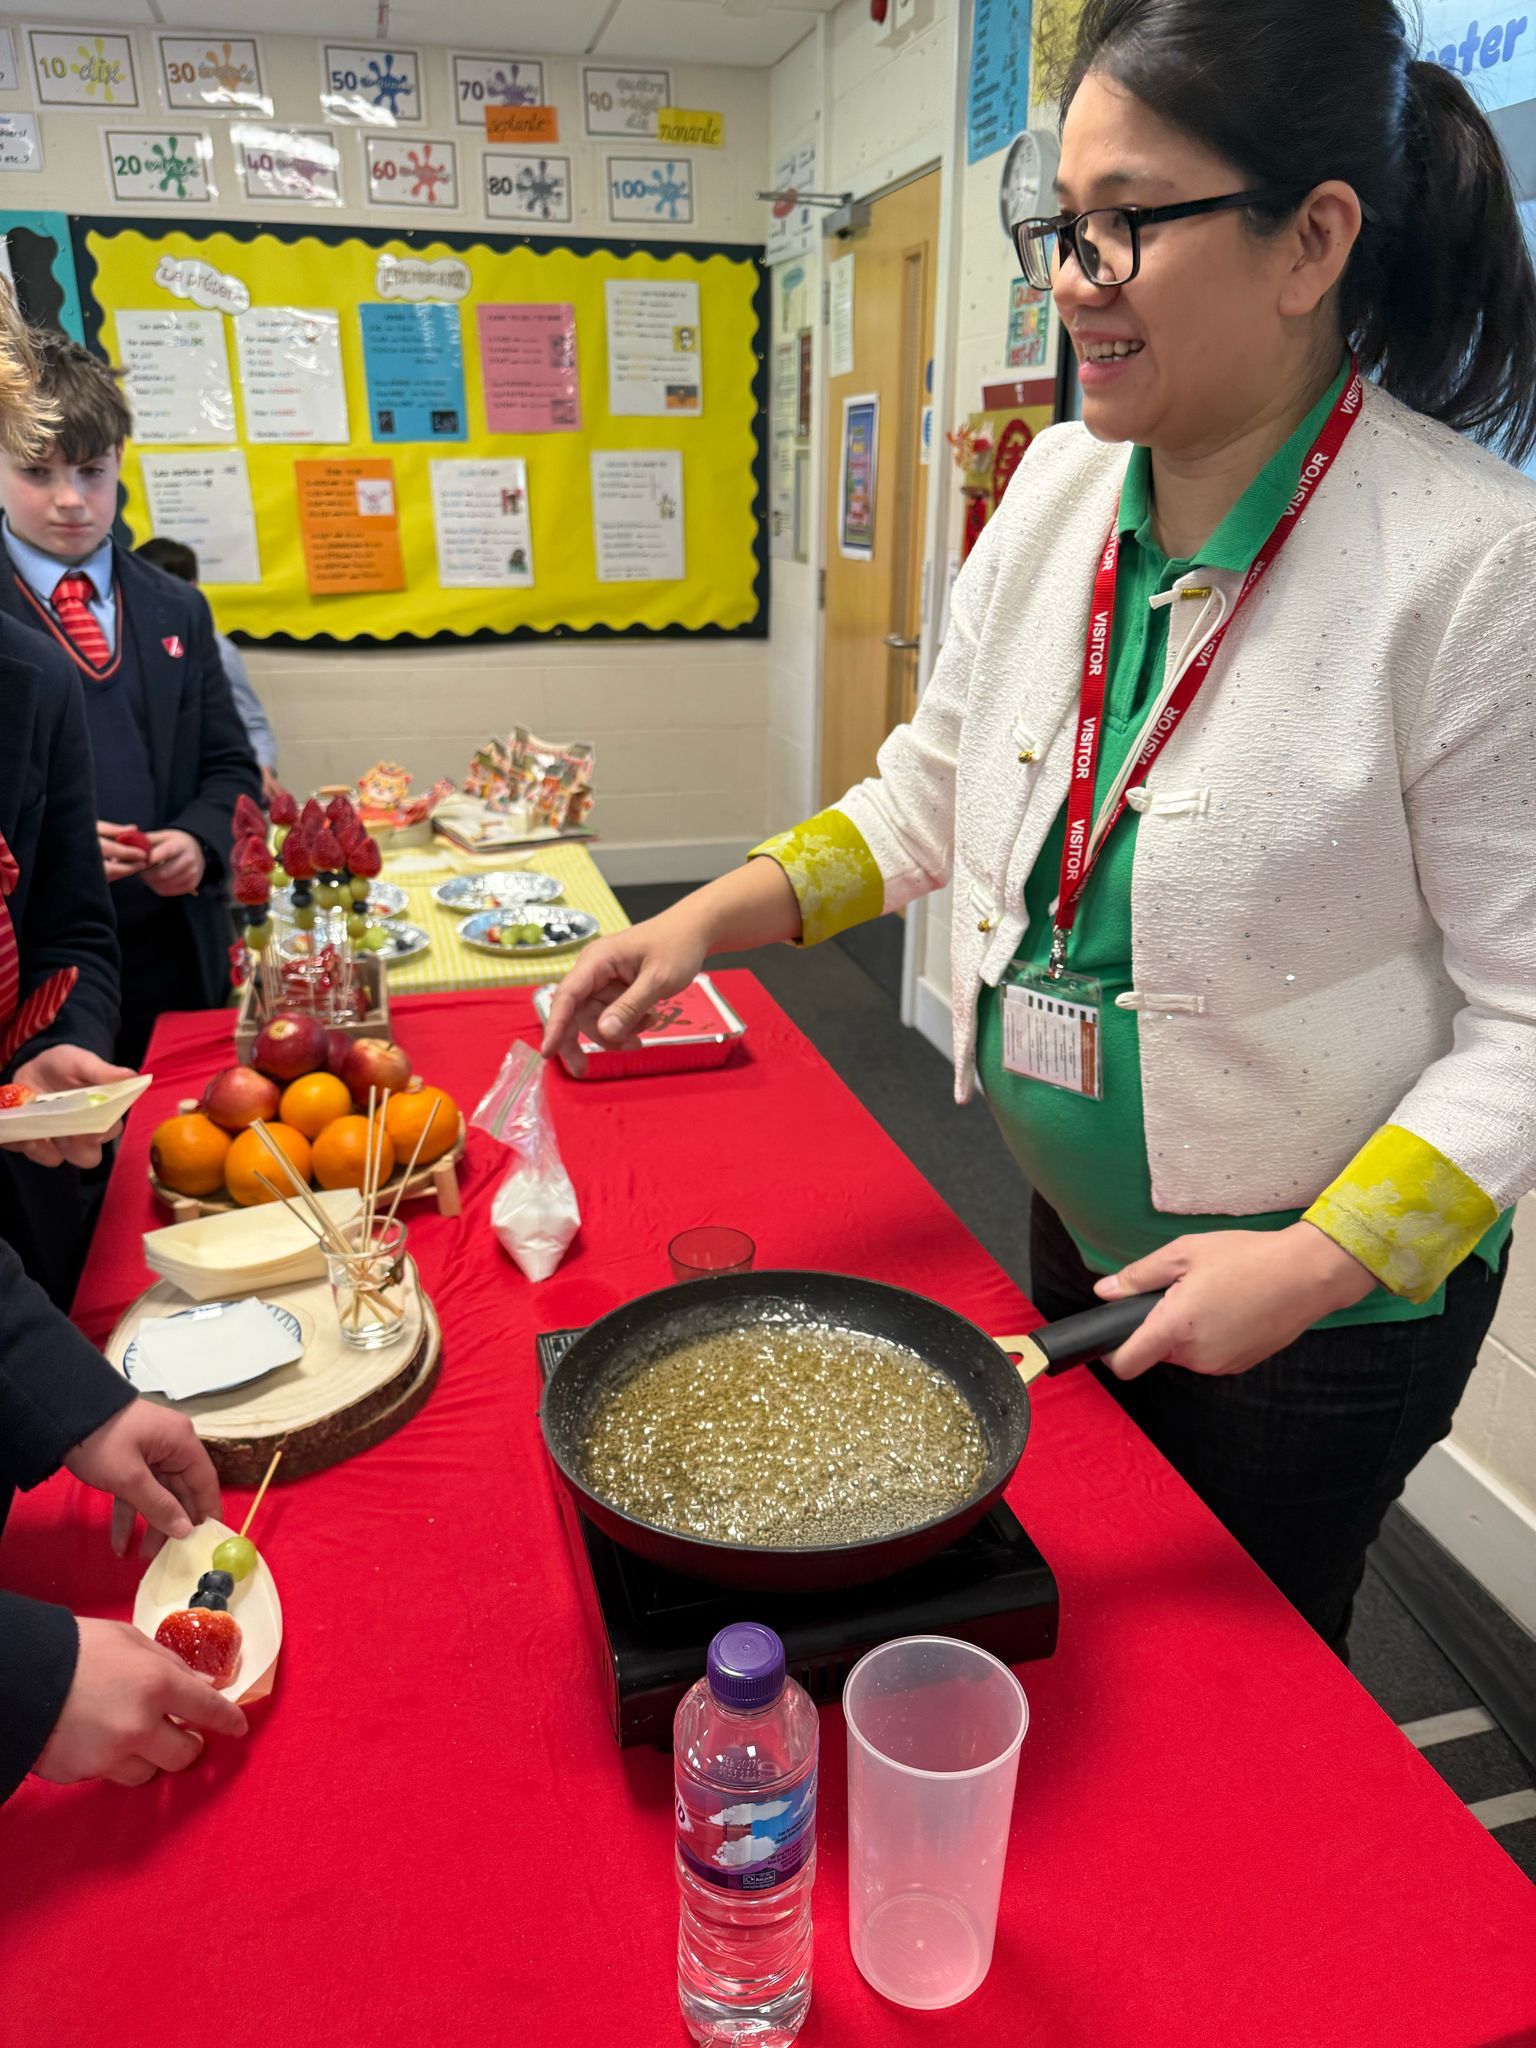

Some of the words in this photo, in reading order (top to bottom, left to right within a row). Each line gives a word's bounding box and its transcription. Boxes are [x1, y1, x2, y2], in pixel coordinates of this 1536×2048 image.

[39, 57, 67, 79] 10
[78, 54, 122, 85] dix
[168, 63, 196, 84] 30
[331, 71, 358, 91] 50
[459, 81, 485, 101] 70
[588, 91, 613, 112] 90
[115, 155, 142, 177] 20
[247, 154, 274, 172] 40
[372, 160, 397, 181] 60
[488, 176, 513, 195] 80
[613, 179, 648, 199] 100
[1340, 374, 1362, 414] VISITO
[1283, 451, 1330, 517] VISITOR
[1089, 611, 1108, 676] VISITOR
[1138, 706, 1181, 766] VISITOR
[1075, 717, 1096, 779] VISITOR
[1066, 819, 1086, 880] VISITOR
